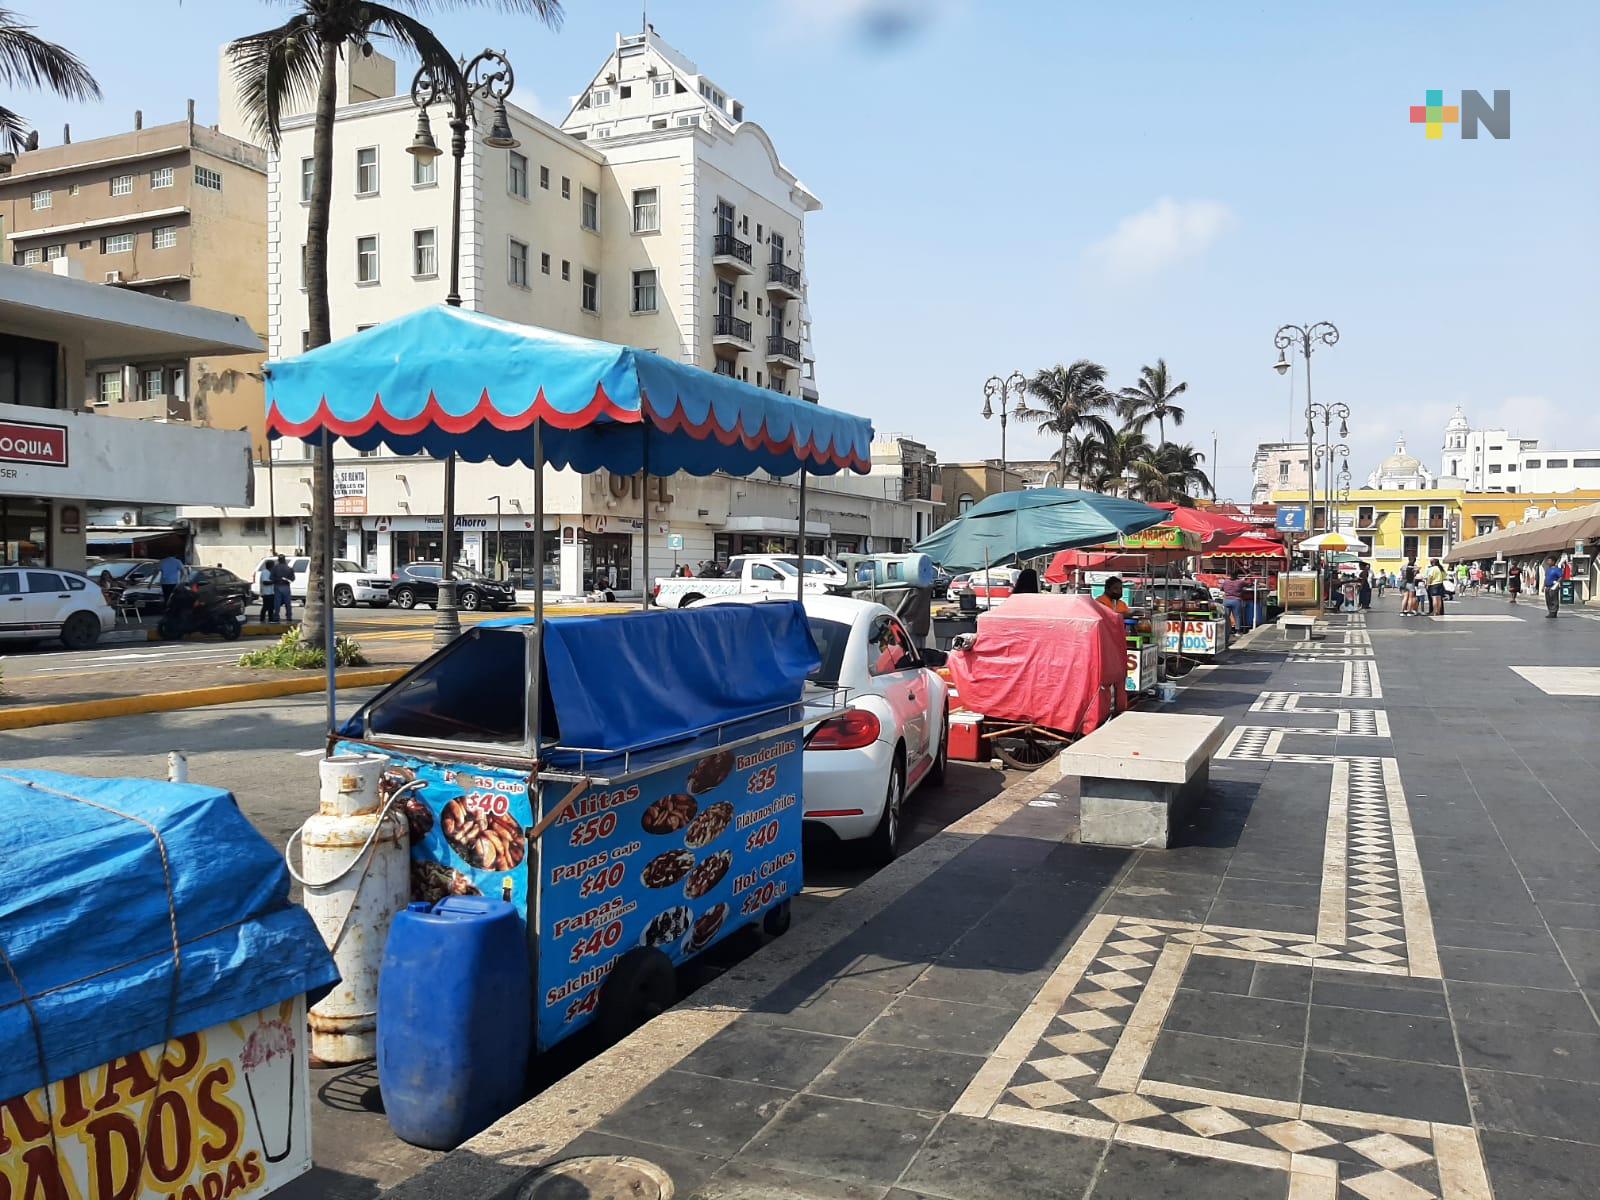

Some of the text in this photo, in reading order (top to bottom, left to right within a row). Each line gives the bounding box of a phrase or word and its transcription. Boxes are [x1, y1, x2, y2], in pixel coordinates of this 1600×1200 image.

[454, 516, 487, 527] Ahorro
[736, 739, 797, 772] Banderillas
[496, 780, 525, 794] Gajo
[747, 763, 777, 794] $35
[466, 791, 510, 817] $40
[554, 784, 641, 827] Alitas
[569, 811, 618, 847] $50
[744, 819, 780, 853] $40
[551, 841, 641, 886] Papas Gajo
[579, 861, 625, 898] $40
[732, 850, 797, 897] Hot Cakes
[740, 880, 775, 917] $20
[552, 896, 624, 940] Papas
[568, 919, 624, 963] $40
[0, 1066, 240, 1200] ADOS
